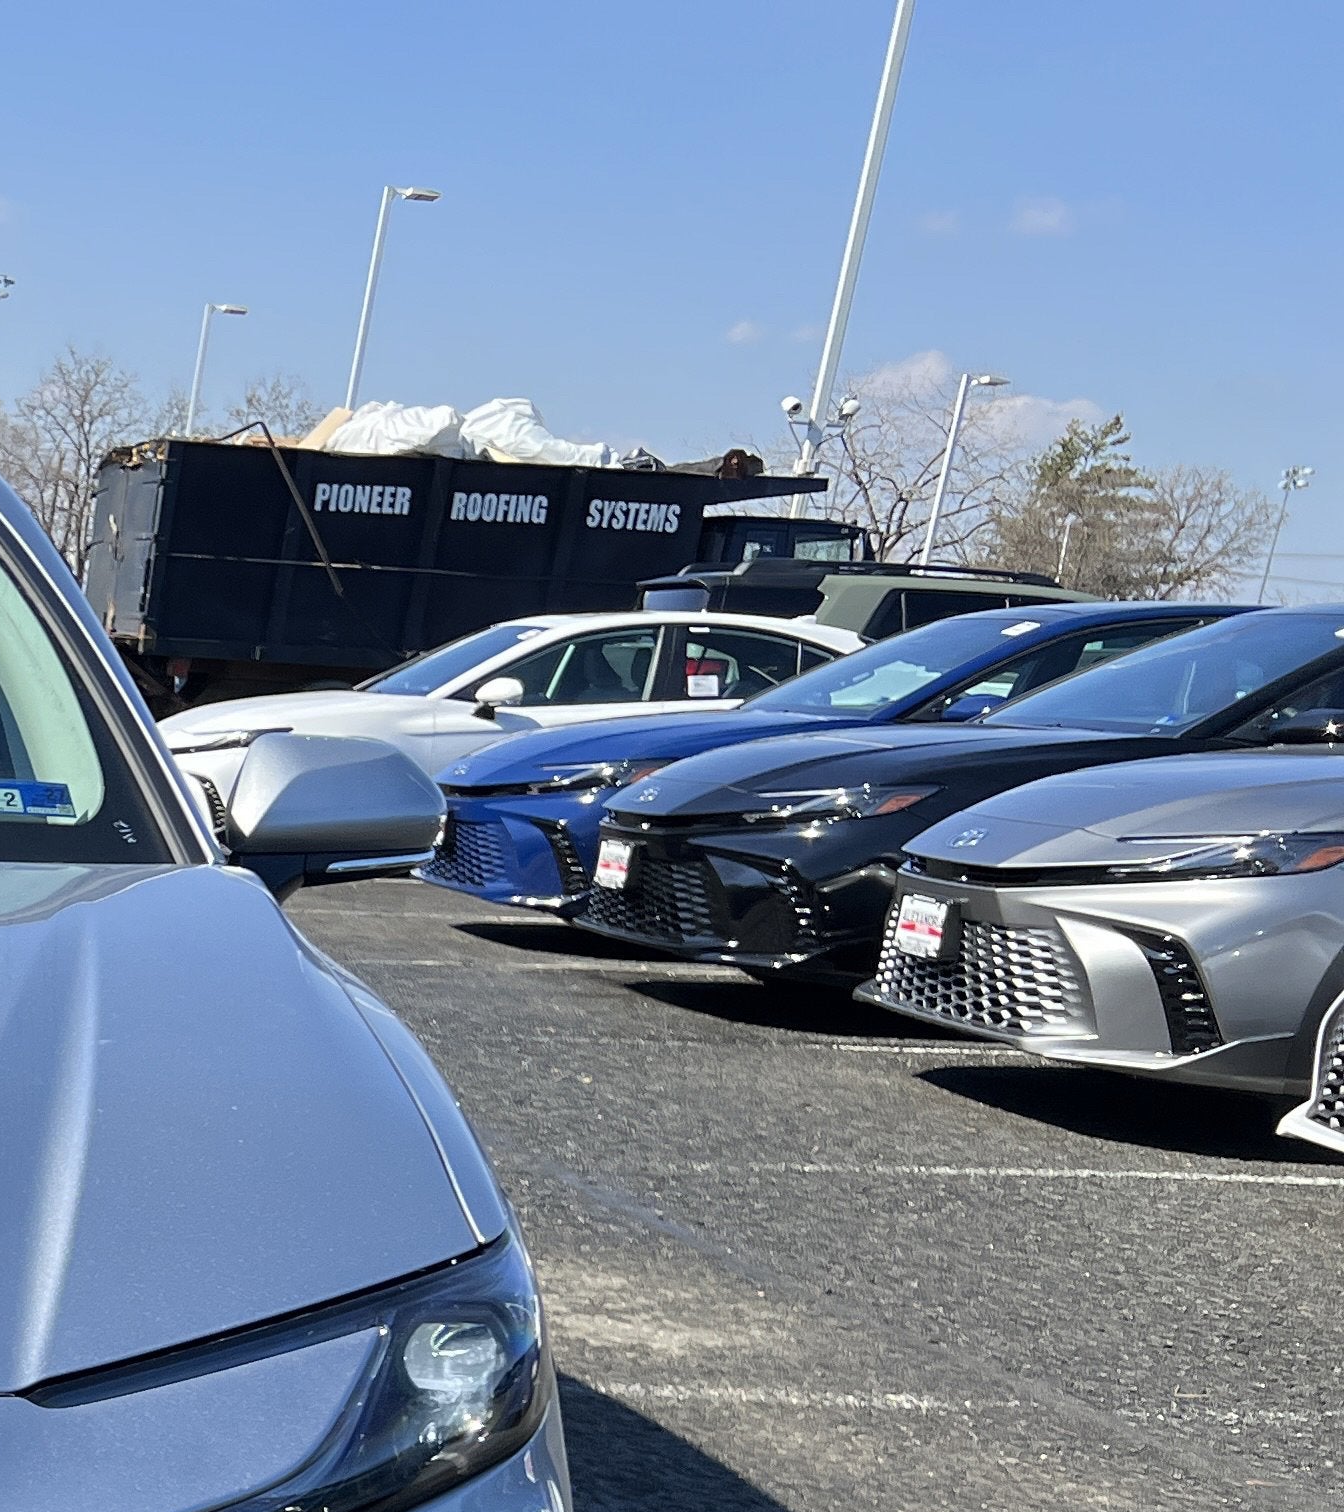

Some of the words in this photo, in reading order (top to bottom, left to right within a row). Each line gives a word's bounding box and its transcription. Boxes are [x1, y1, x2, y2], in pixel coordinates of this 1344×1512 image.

[313, 482, 412, 516] PIONEER
[450, 491, 549, 524] ROOFING
[585, 499, 681, 533] SYSTEMS
[3, 791, 18, 807] 2
